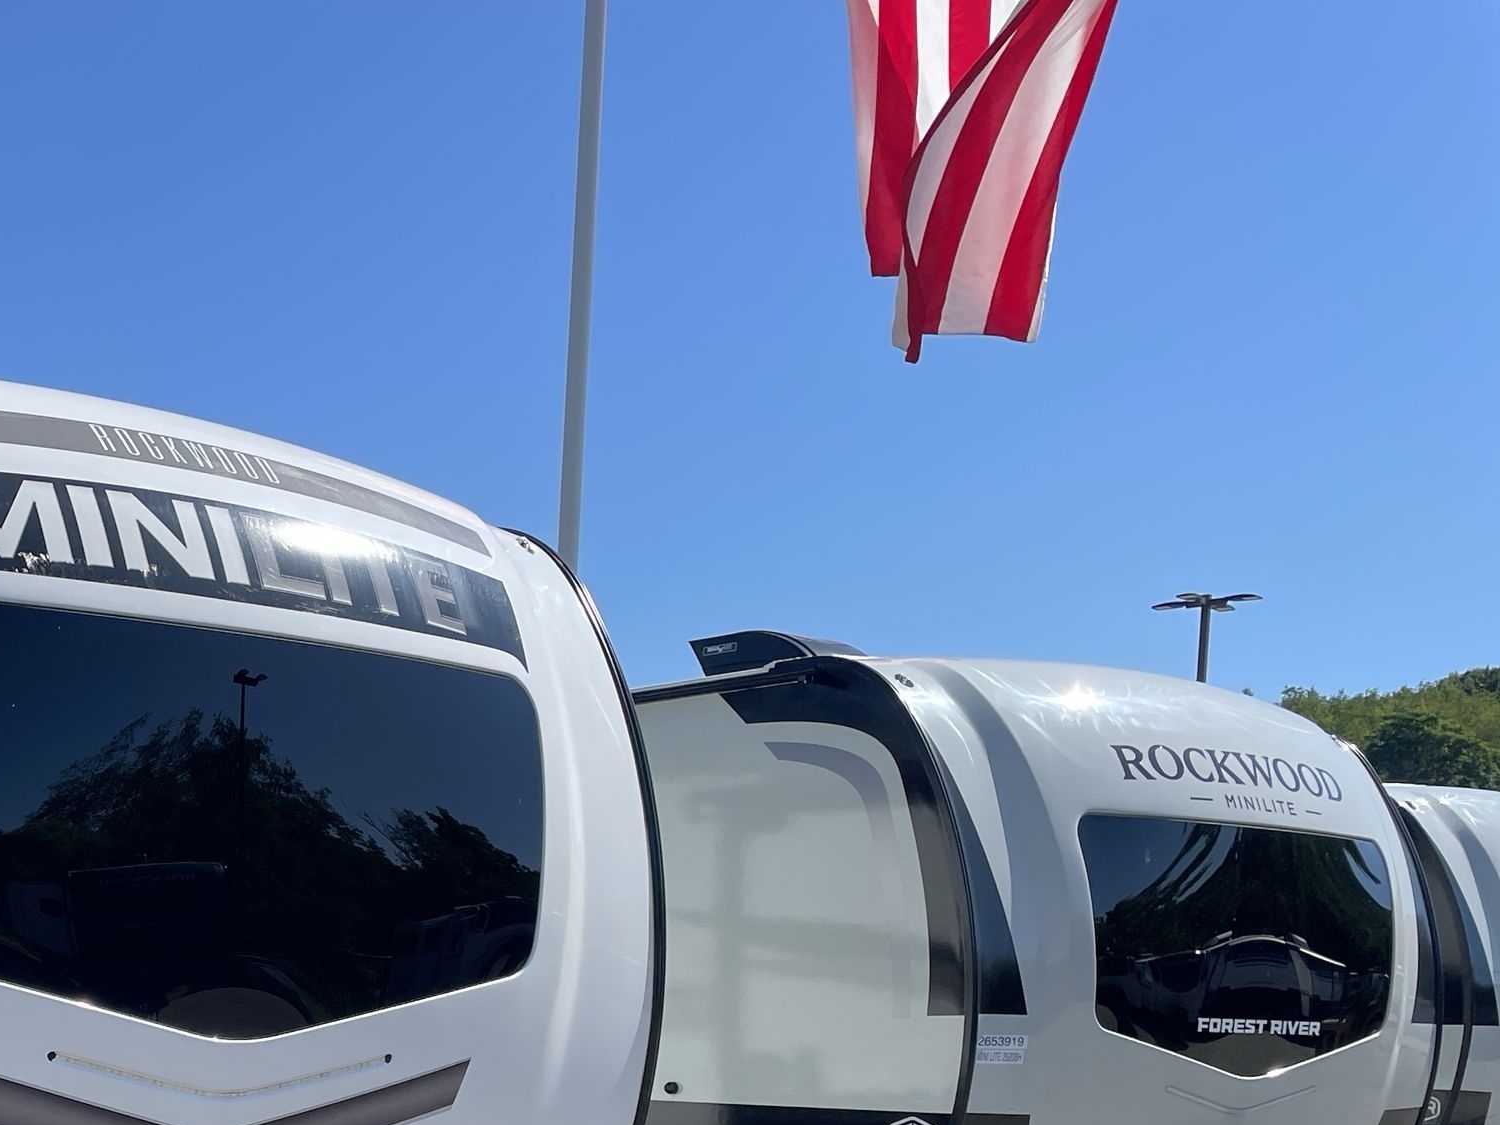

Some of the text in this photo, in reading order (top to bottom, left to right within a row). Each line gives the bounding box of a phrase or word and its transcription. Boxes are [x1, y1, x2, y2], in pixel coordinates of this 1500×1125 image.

[89, 423, 280, 484] ROCKWOOD
[1110, 744, 1343, 802] ROCKWOOD
[1224, 794, 1298, 816] MINILITE
[1197, 1017, 1321, 1036] FOREST RIVER
[978, 1036, 1025, 1047] 2653919
